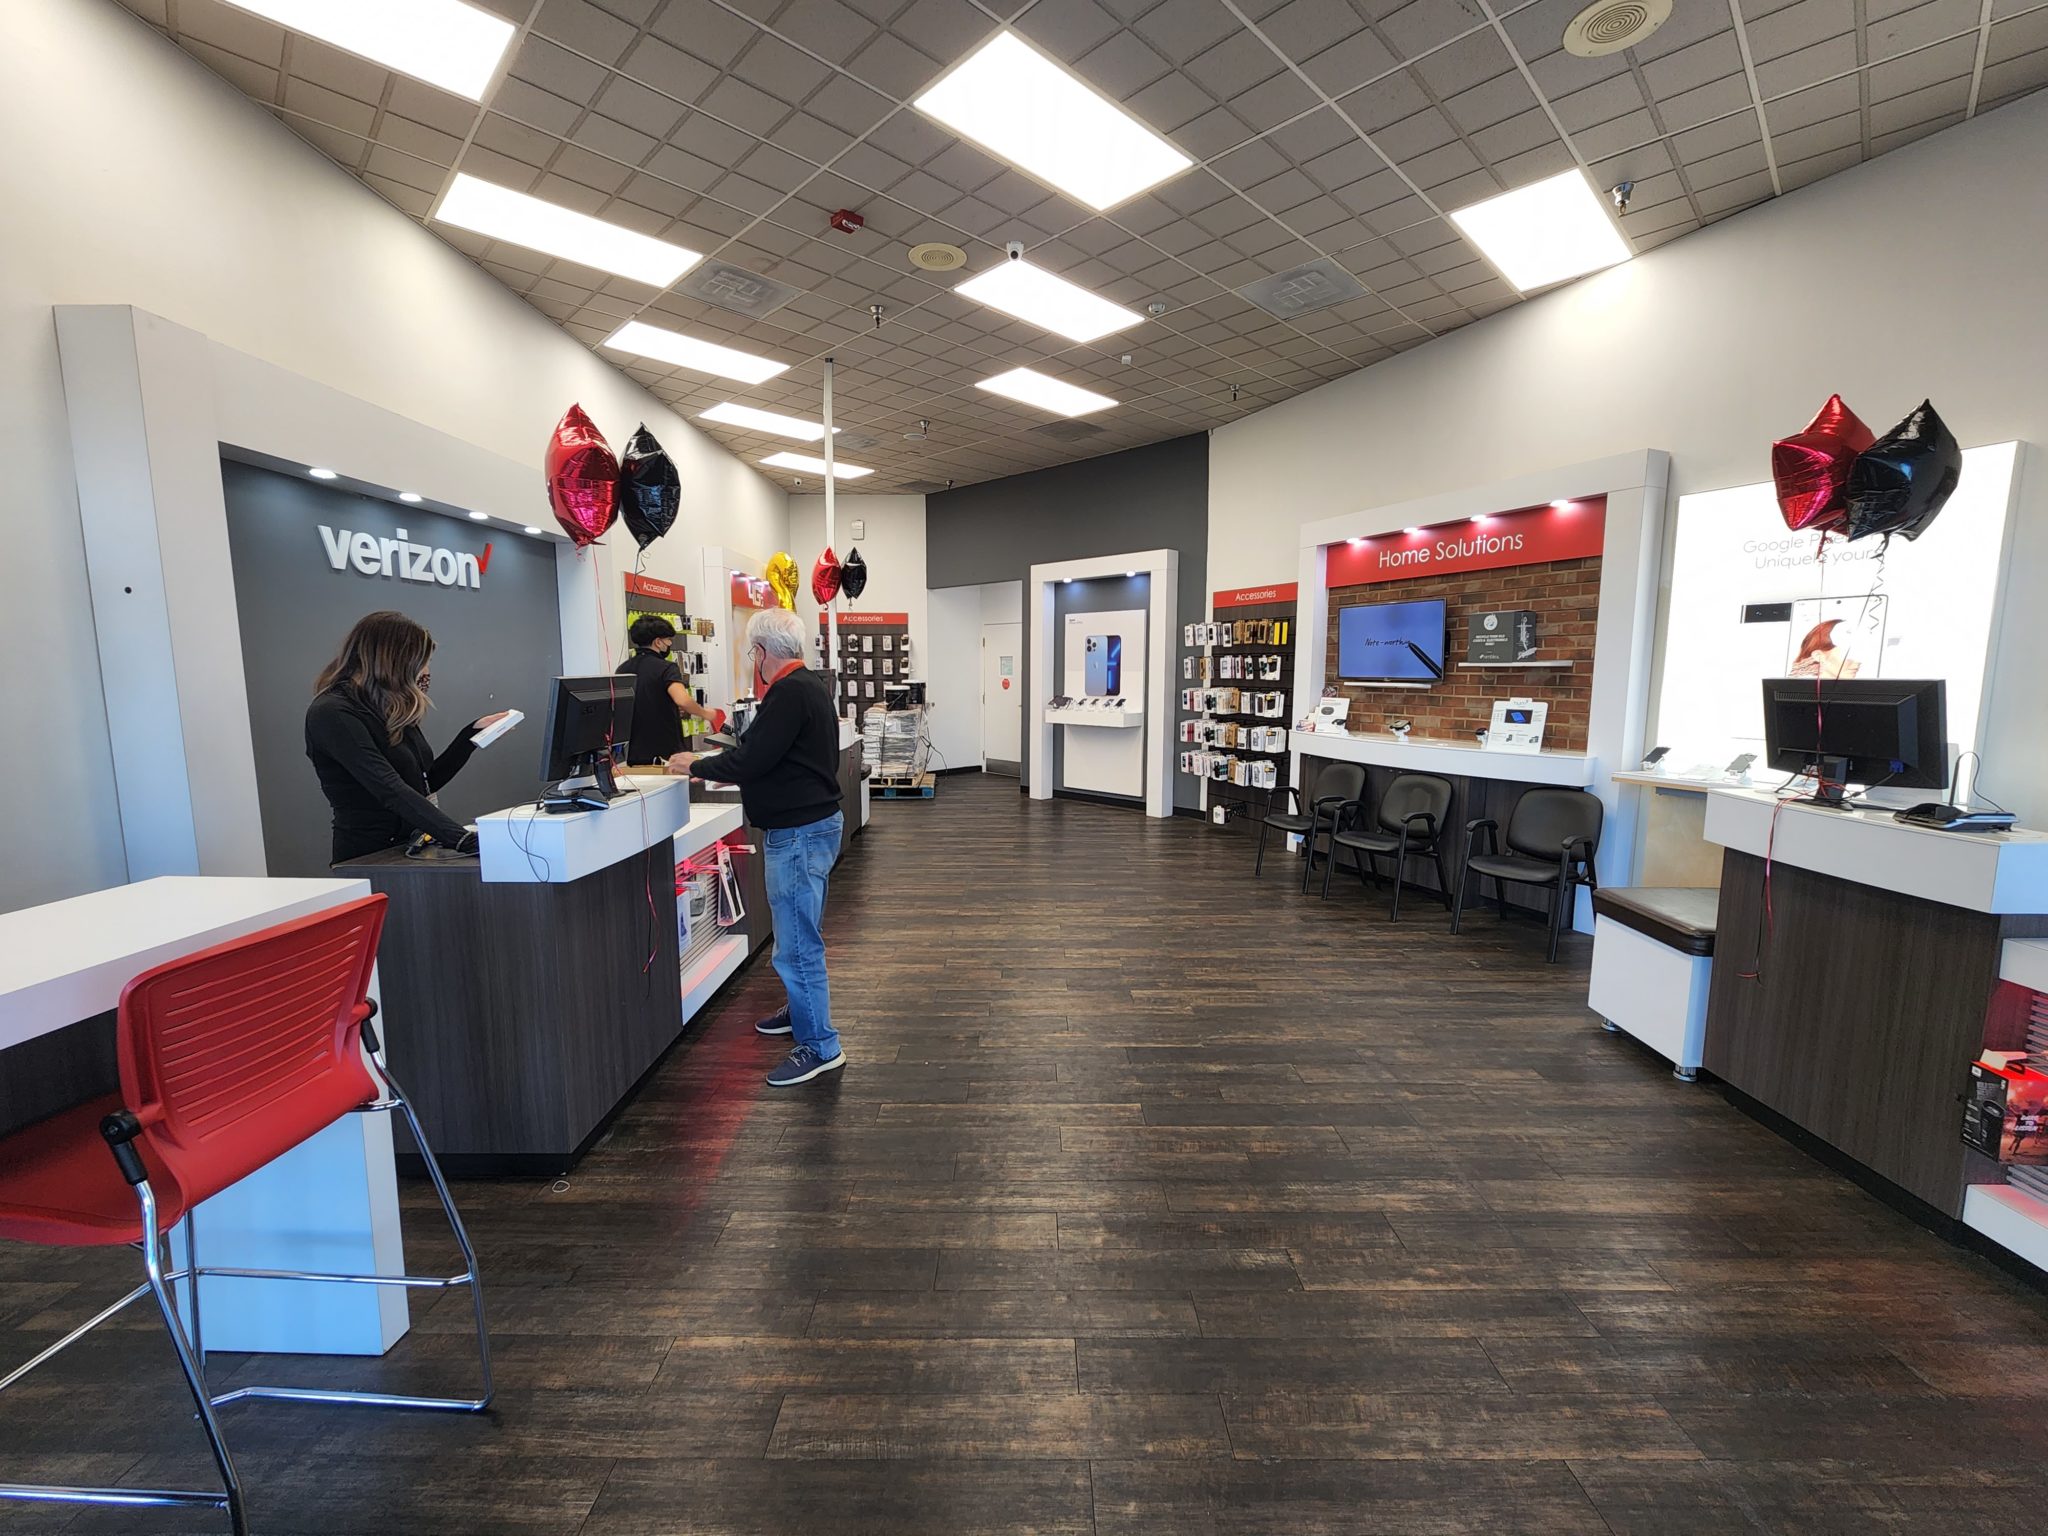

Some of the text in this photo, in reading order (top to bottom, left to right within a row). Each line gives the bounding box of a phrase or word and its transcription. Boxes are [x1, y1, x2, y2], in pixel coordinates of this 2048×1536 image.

[1379, 534, 1523, 568] Home Solutions
[1743, 534, 1804, 553] Google
[317, 525, 480, 588] verizon
[643, 580, 672, 595] Accessories
[1235, 589, 1277, 601] Accessories
